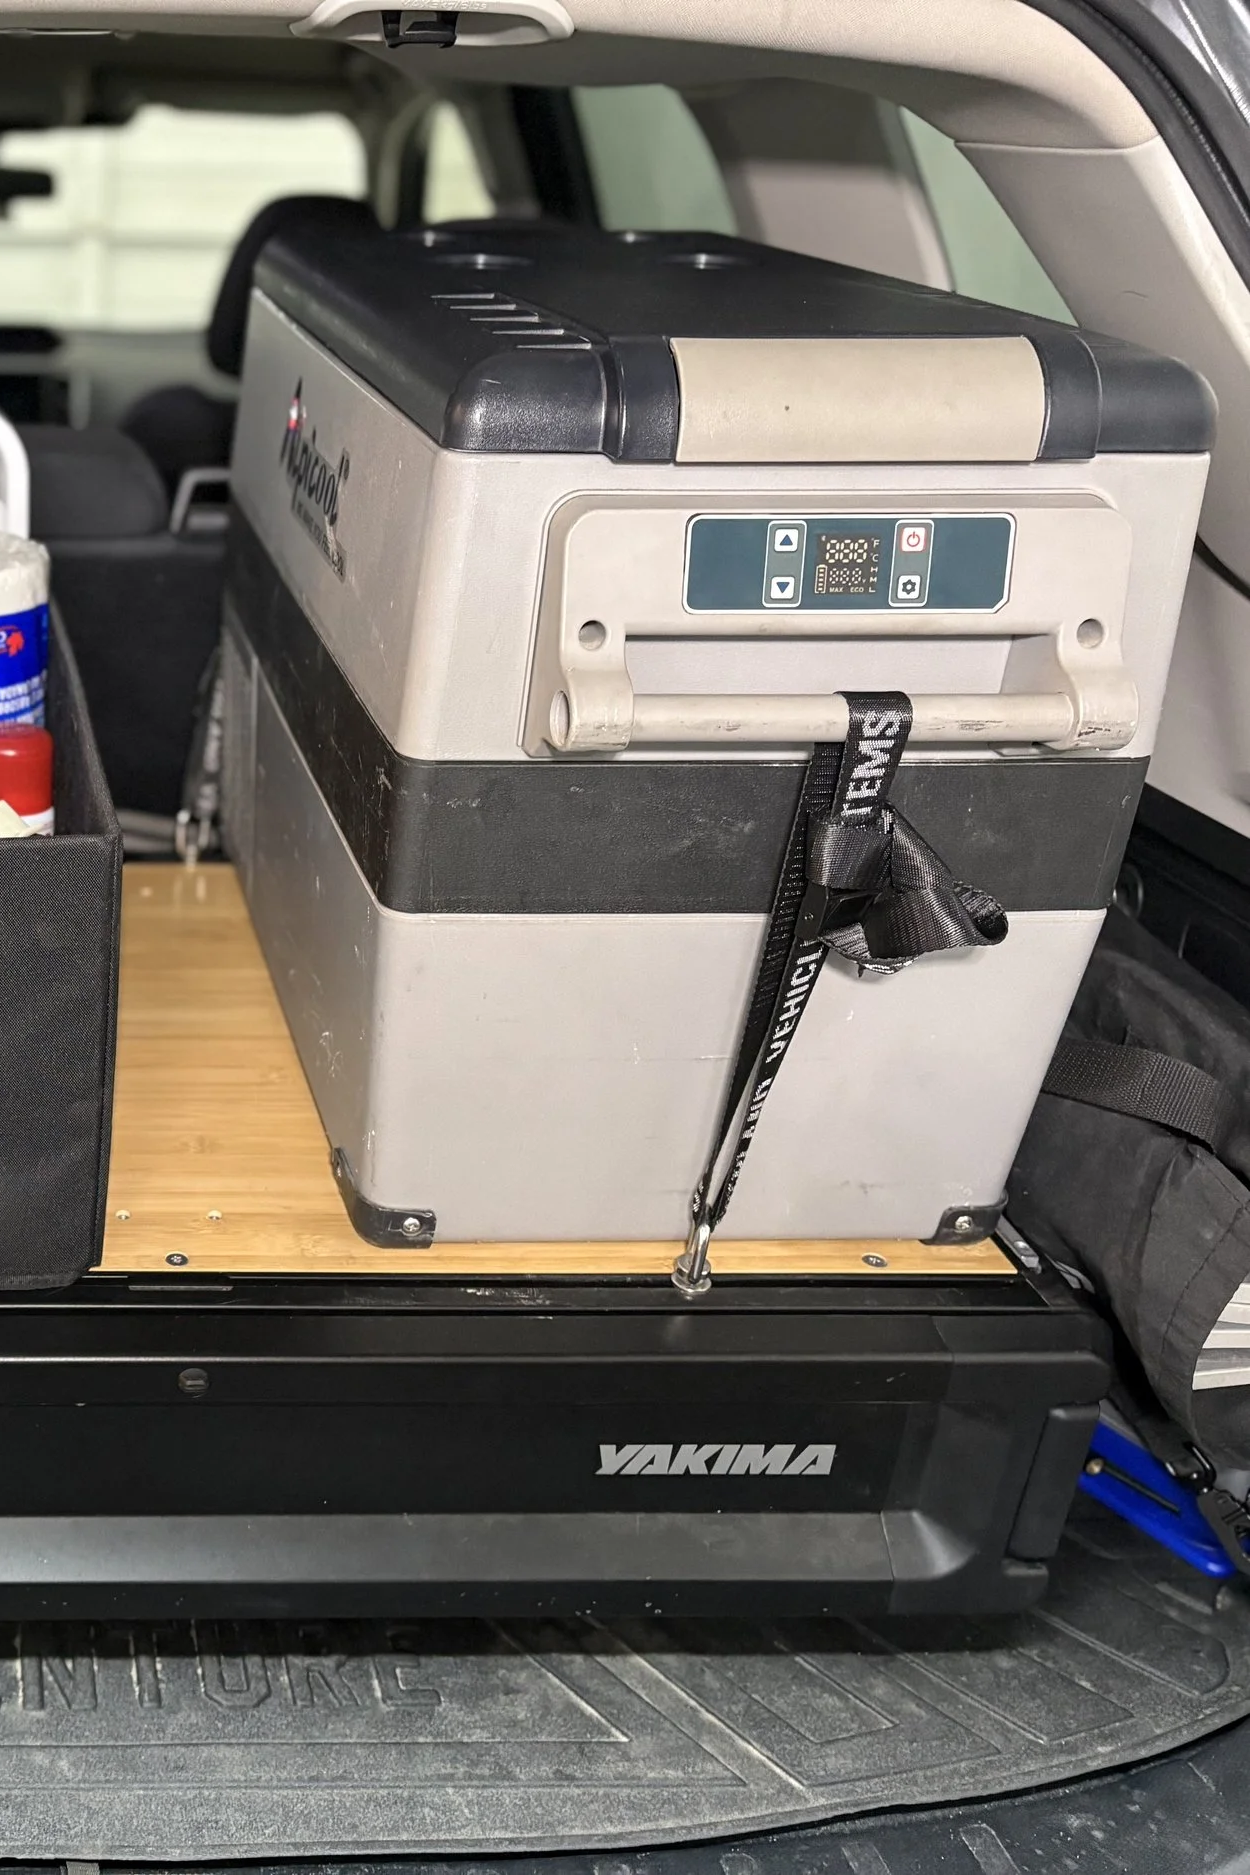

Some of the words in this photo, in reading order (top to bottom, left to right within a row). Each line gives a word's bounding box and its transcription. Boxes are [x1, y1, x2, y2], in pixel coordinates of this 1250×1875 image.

[841, 711, 902, 817] TEMS
[766, 939, 823, 1063] VEHICL
[595, 1444, 836, 1475] YAKIMA
